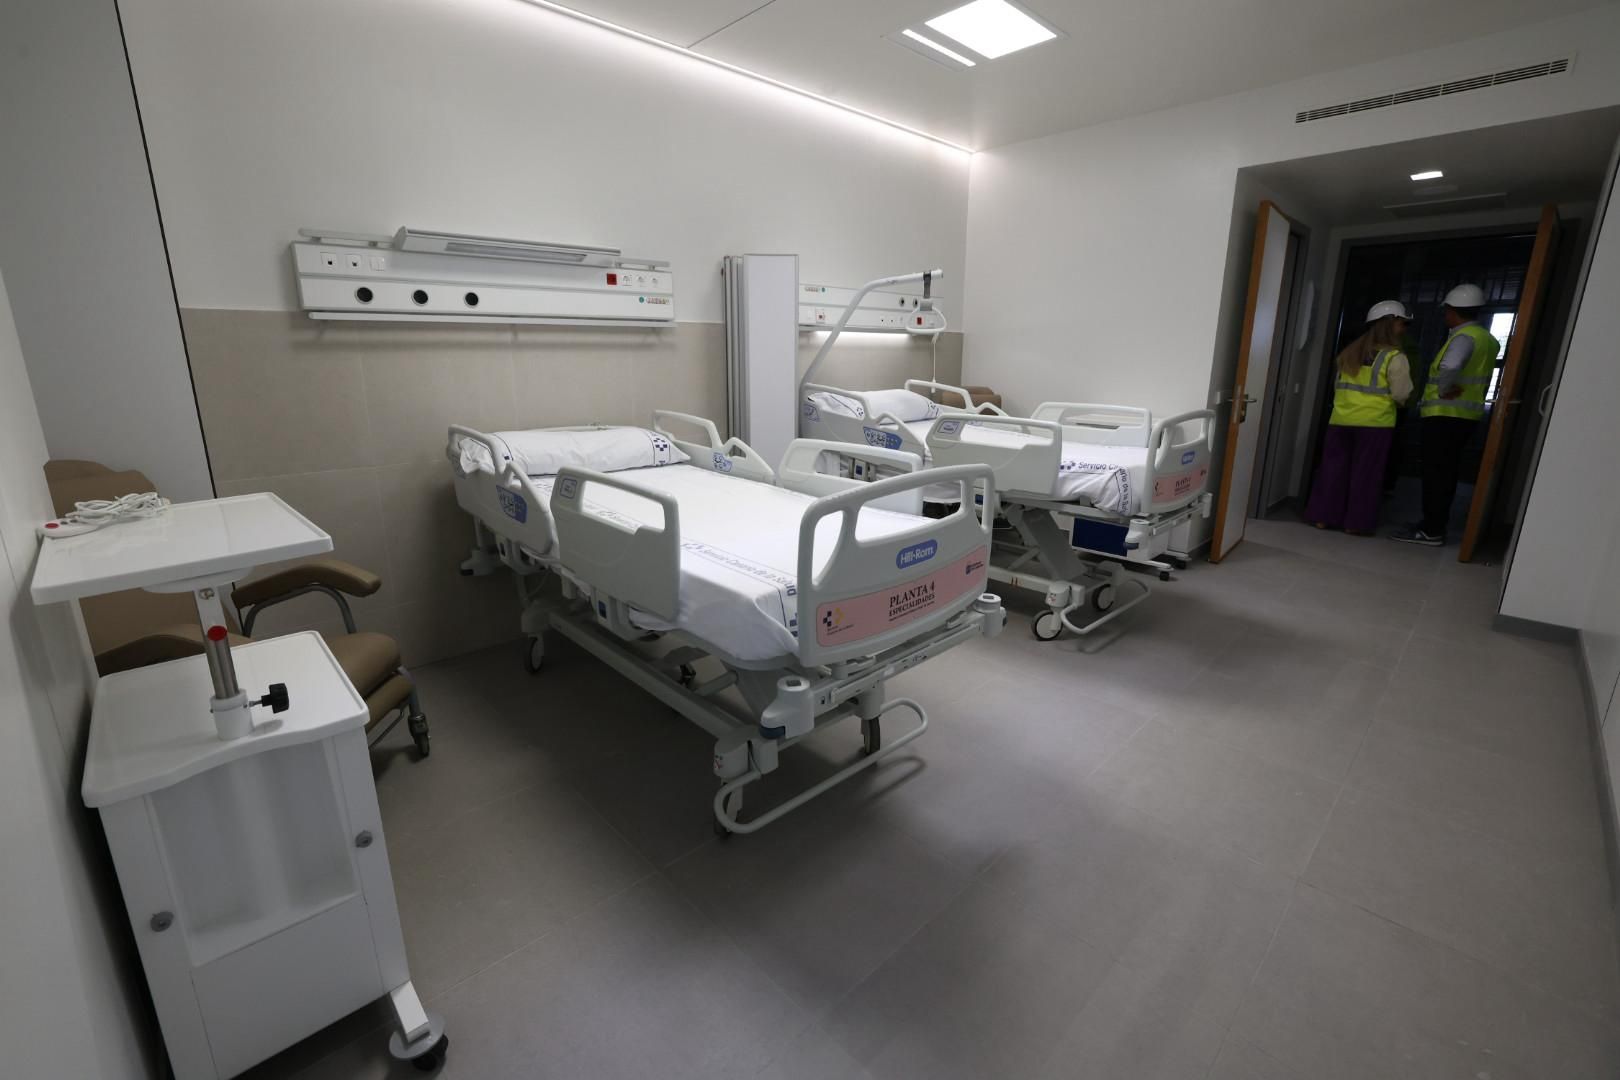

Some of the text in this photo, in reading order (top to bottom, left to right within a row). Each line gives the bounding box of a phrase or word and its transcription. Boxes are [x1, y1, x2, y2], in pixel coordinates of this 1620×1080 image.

[888, 593, 936, 617] ESPECIALIDADES
[889, 579, 936, 608] PLANTA 4
